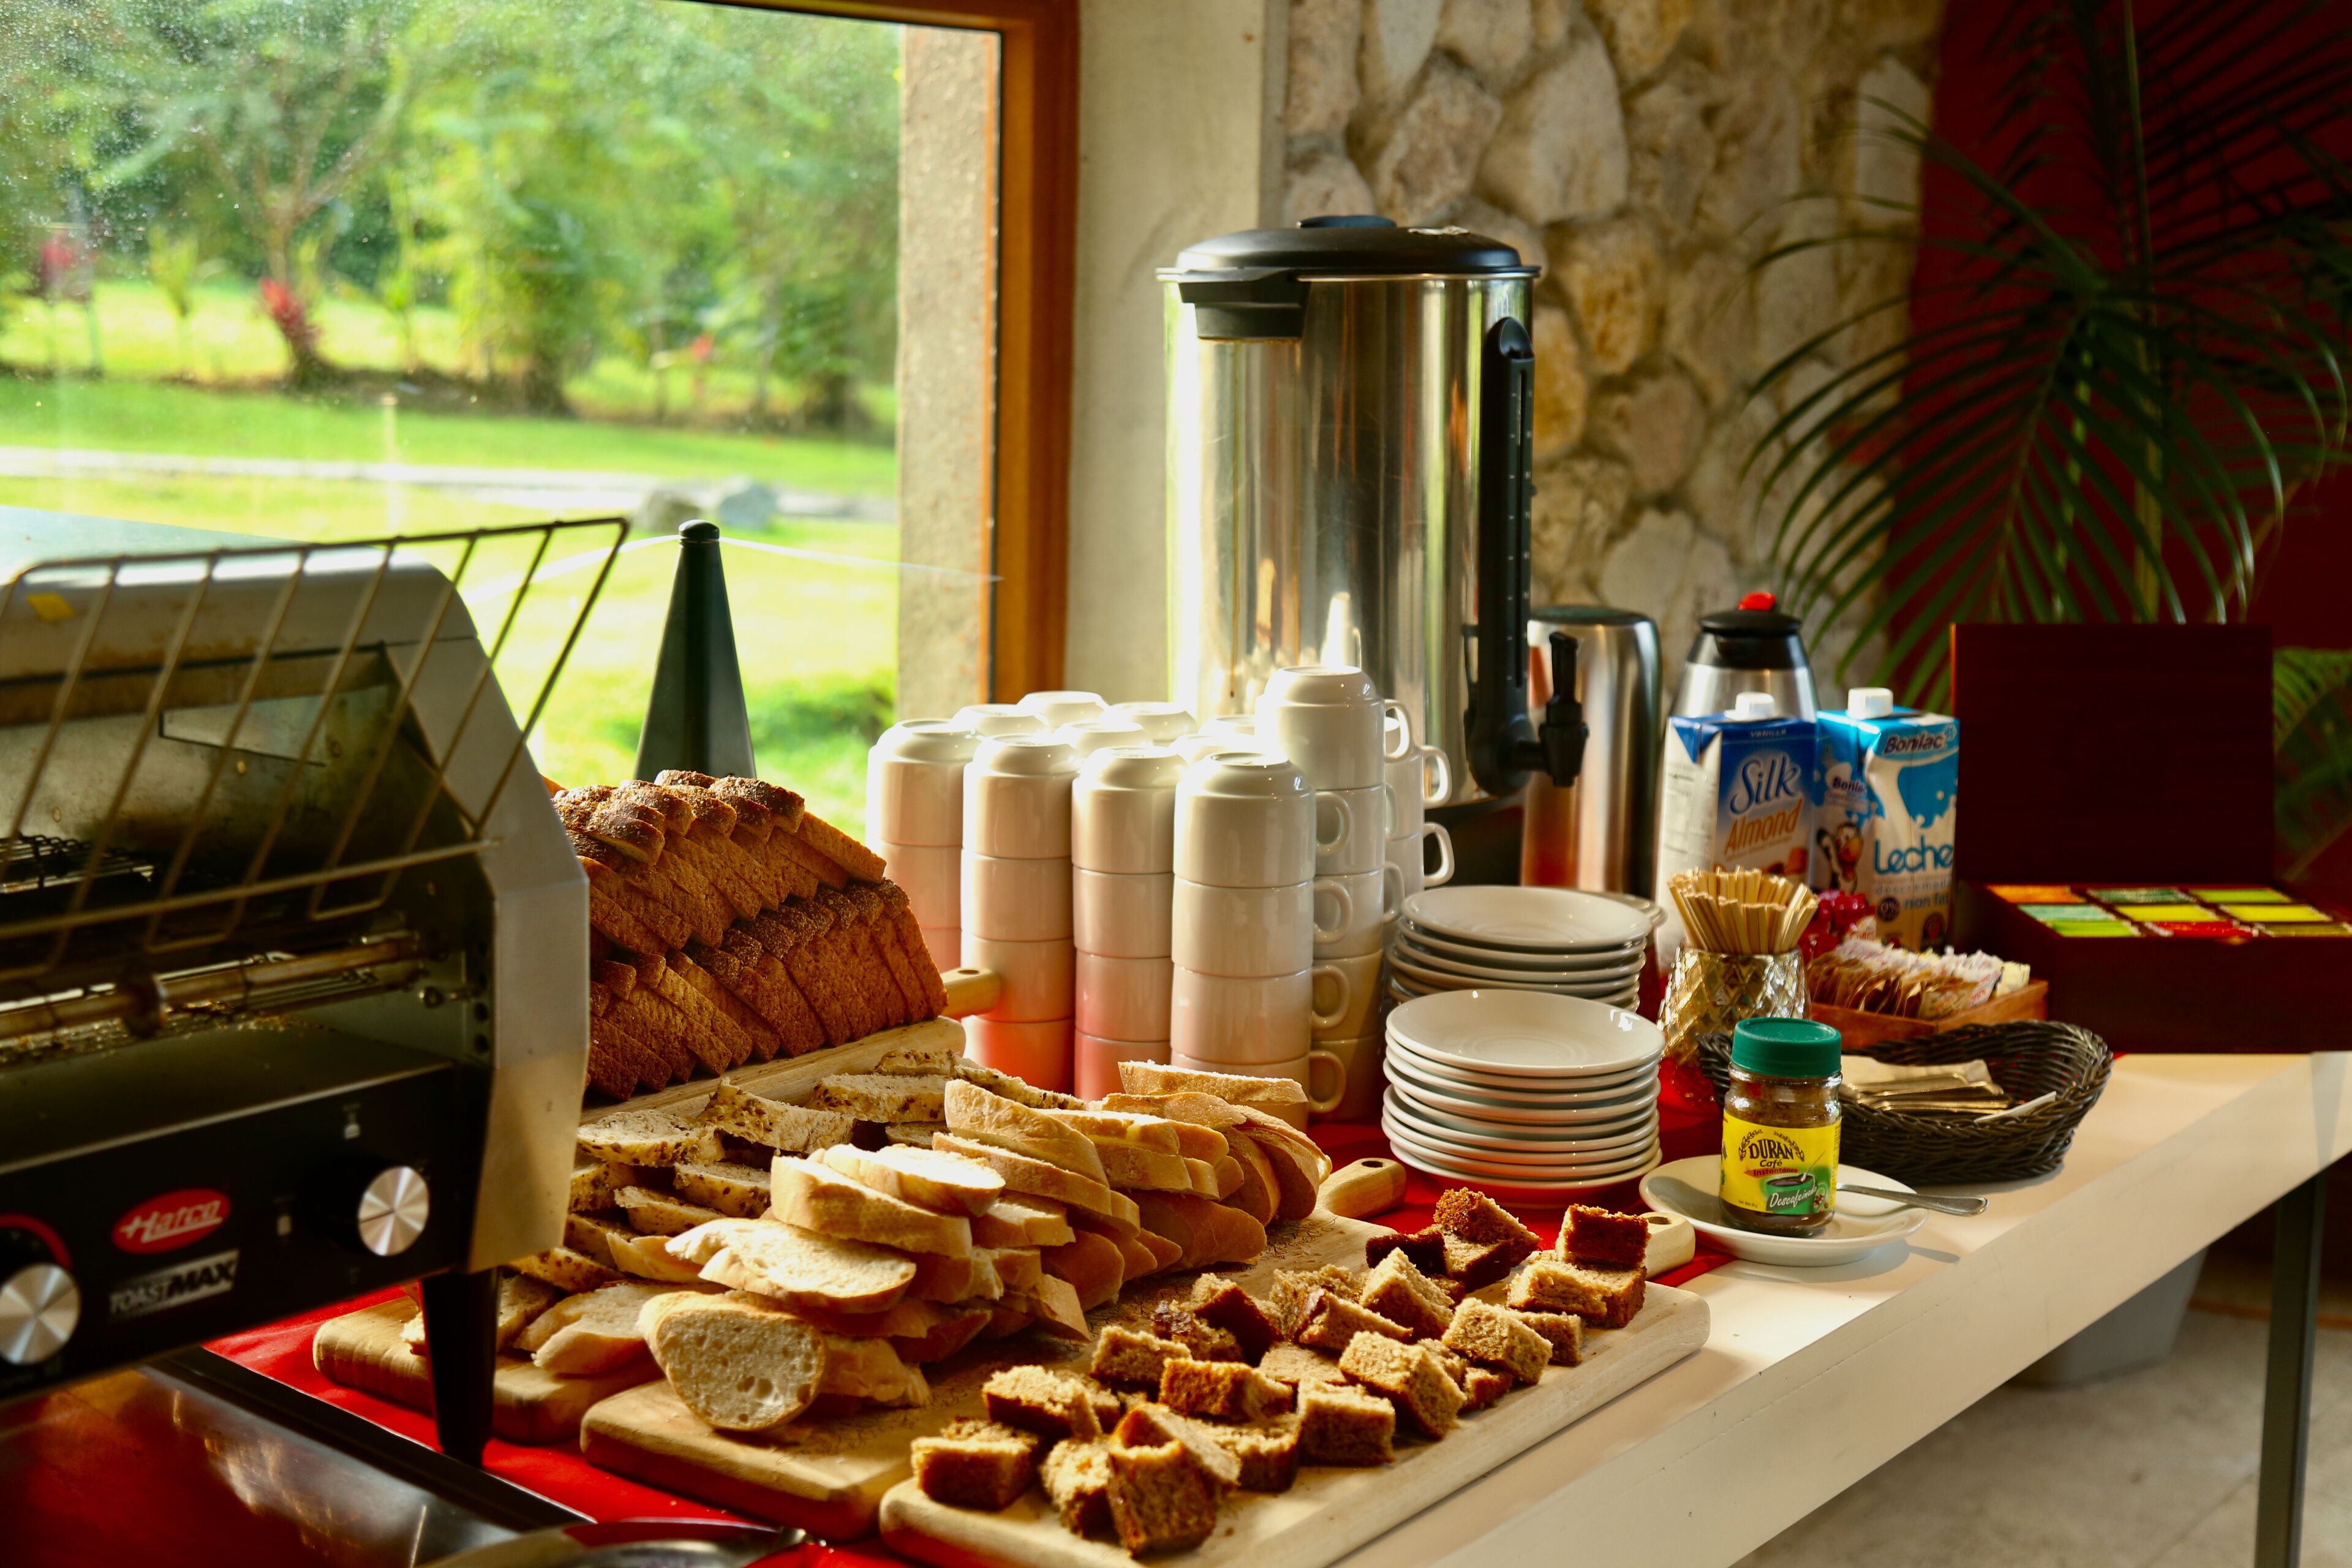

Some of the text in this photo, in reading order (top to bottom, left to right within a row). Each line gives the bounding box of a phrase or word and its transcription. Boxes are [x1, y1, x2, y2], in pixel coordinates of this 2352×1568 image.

[1883, 731, 1945, 755] Bonlac
[1730, 755, 1801, 815] Silk
[1724, 797, 1803, 855] Almond
[1875, 835, 1953, 875] Leche
[1748, 1138, 1794, 1160] DURAN
[1753, 1167, 1799, 1177] Instantáneo
[1759, 1159, 1782, 1169] Café
[1770, 1185, 1818, 1208] Descafeinado
[119, 1199, 222, 1244] Hatco
